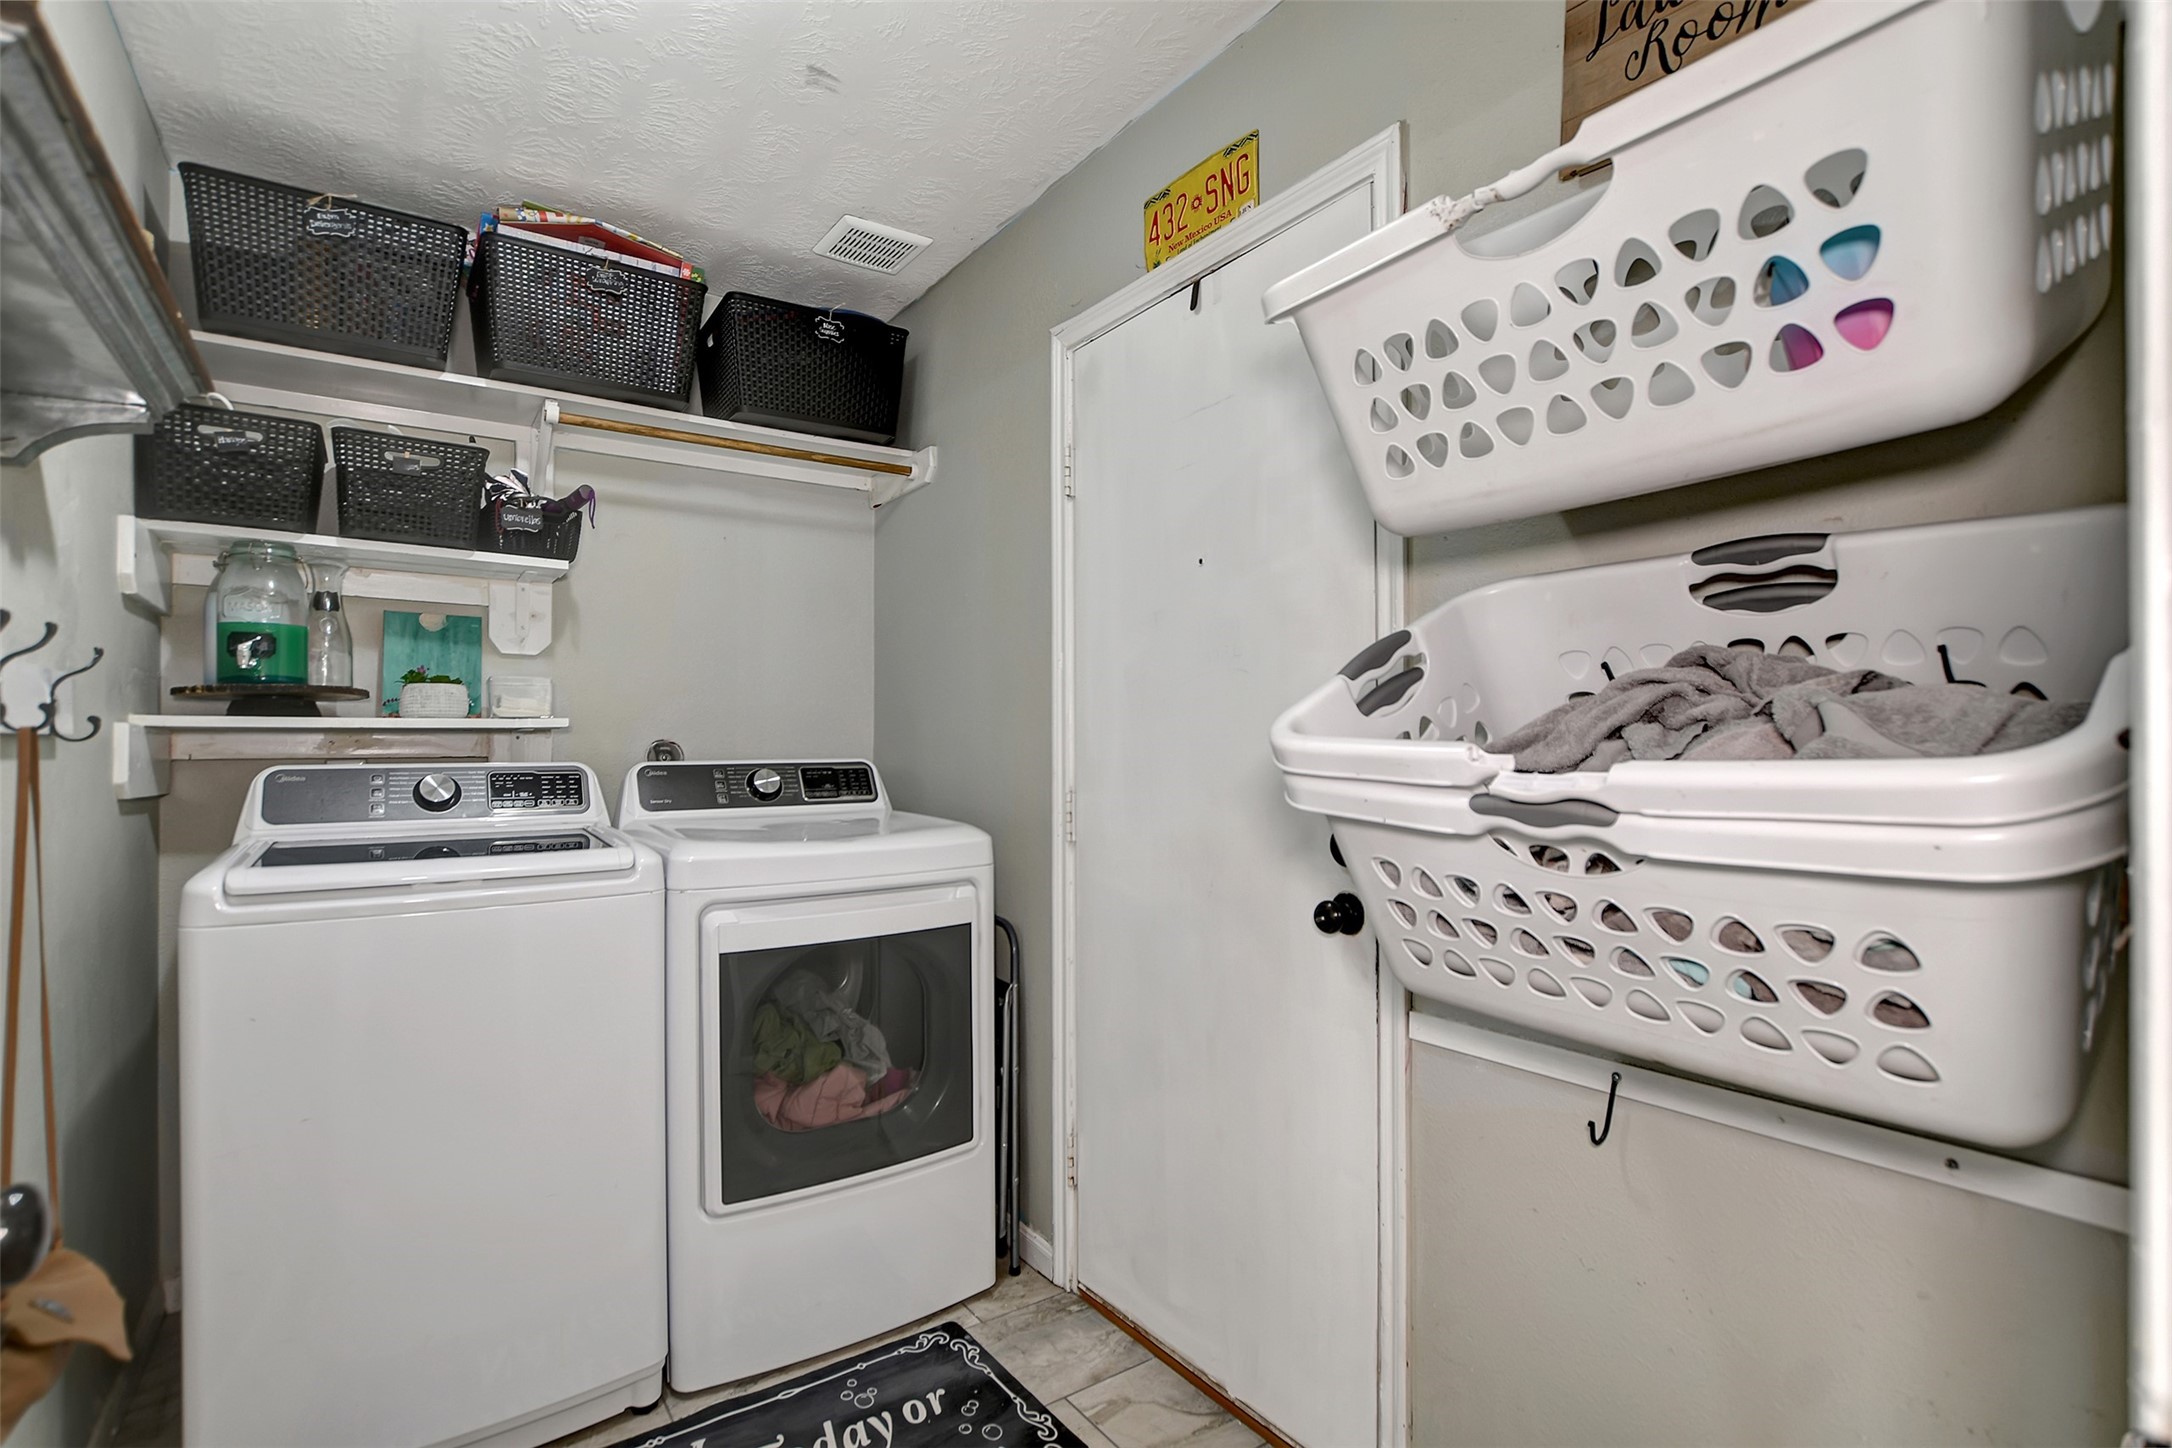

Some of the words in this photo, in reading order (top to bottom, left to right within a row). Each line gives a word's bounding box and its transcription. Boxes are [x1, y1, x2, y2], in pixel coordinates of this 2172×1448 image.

[1149, 193, 1188, 246] 432
[1205, 153, 1250, 214] SNG
[1168, 240, 1183, 253] New
[1184, 222, 1212, 243] Mexico
[1214, 209, 1232, 225] USA
[902, 1388, 946, 1424] or
